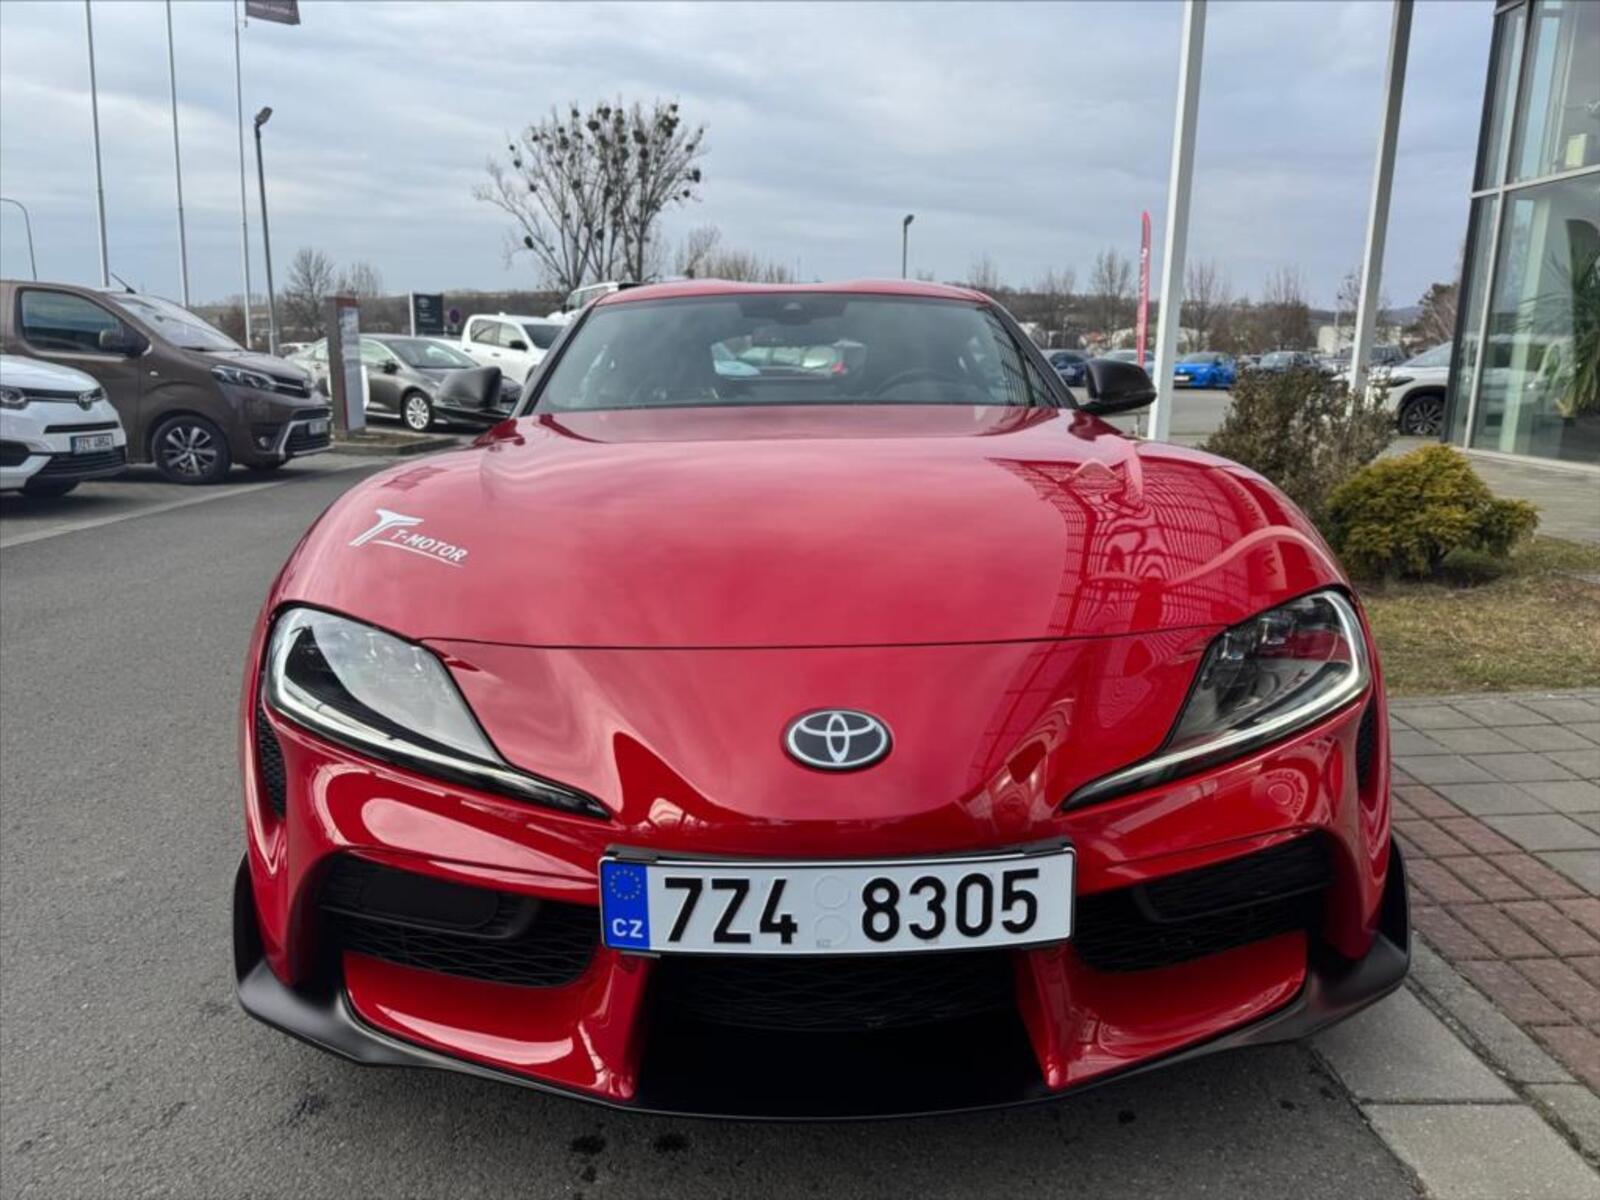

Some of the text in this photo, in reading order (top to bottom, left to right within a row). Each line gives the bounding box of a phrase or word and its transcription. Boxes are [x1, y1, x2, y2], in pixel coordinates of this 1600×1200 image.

[390, 529, 468, 562] T-MOTOR
[665, 868, 1039, 944] 7Z4 8305
[612, 918, 643, 938] CZ
